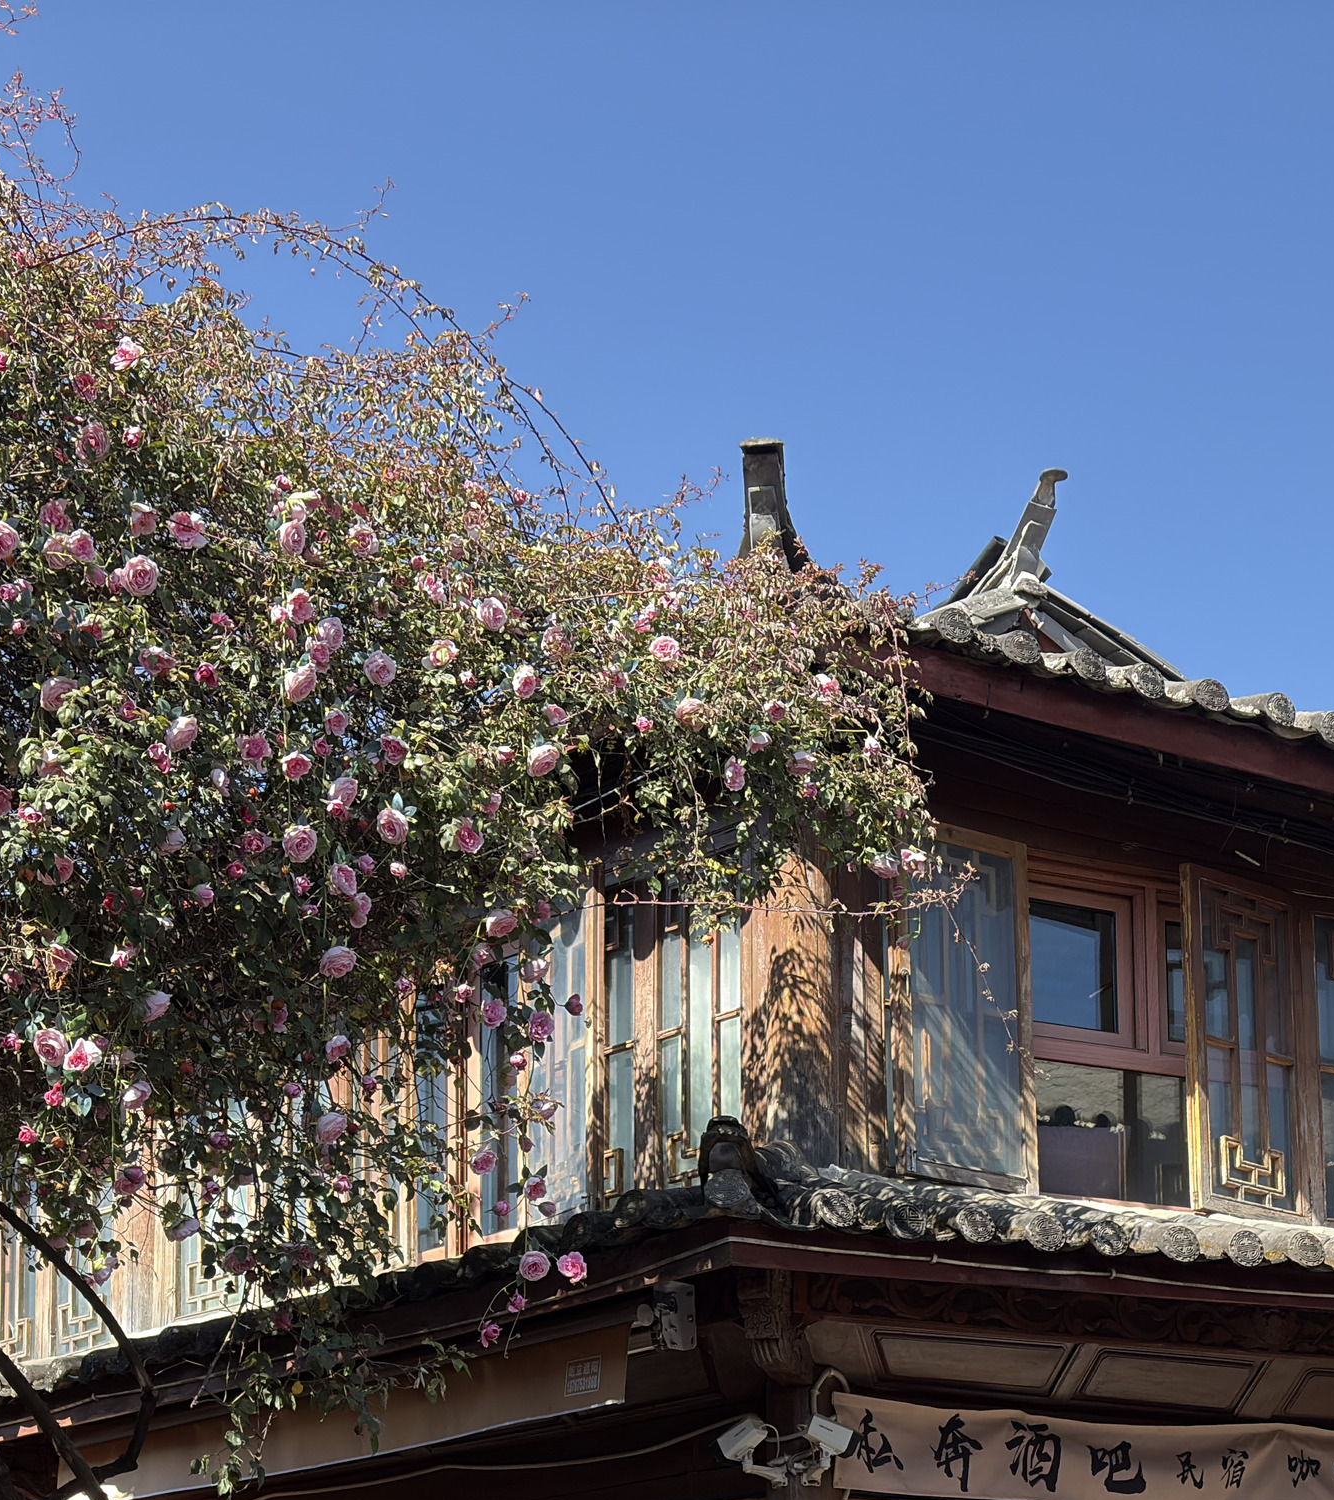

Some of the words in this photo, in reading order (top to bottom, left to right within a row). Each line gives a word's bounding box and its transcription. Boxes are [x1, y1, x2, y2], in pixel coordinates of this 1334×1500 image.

[851, 1410, 1144, 1493] 私奔酒吧
[1176, 1448, 1249, 1490] 民宿
